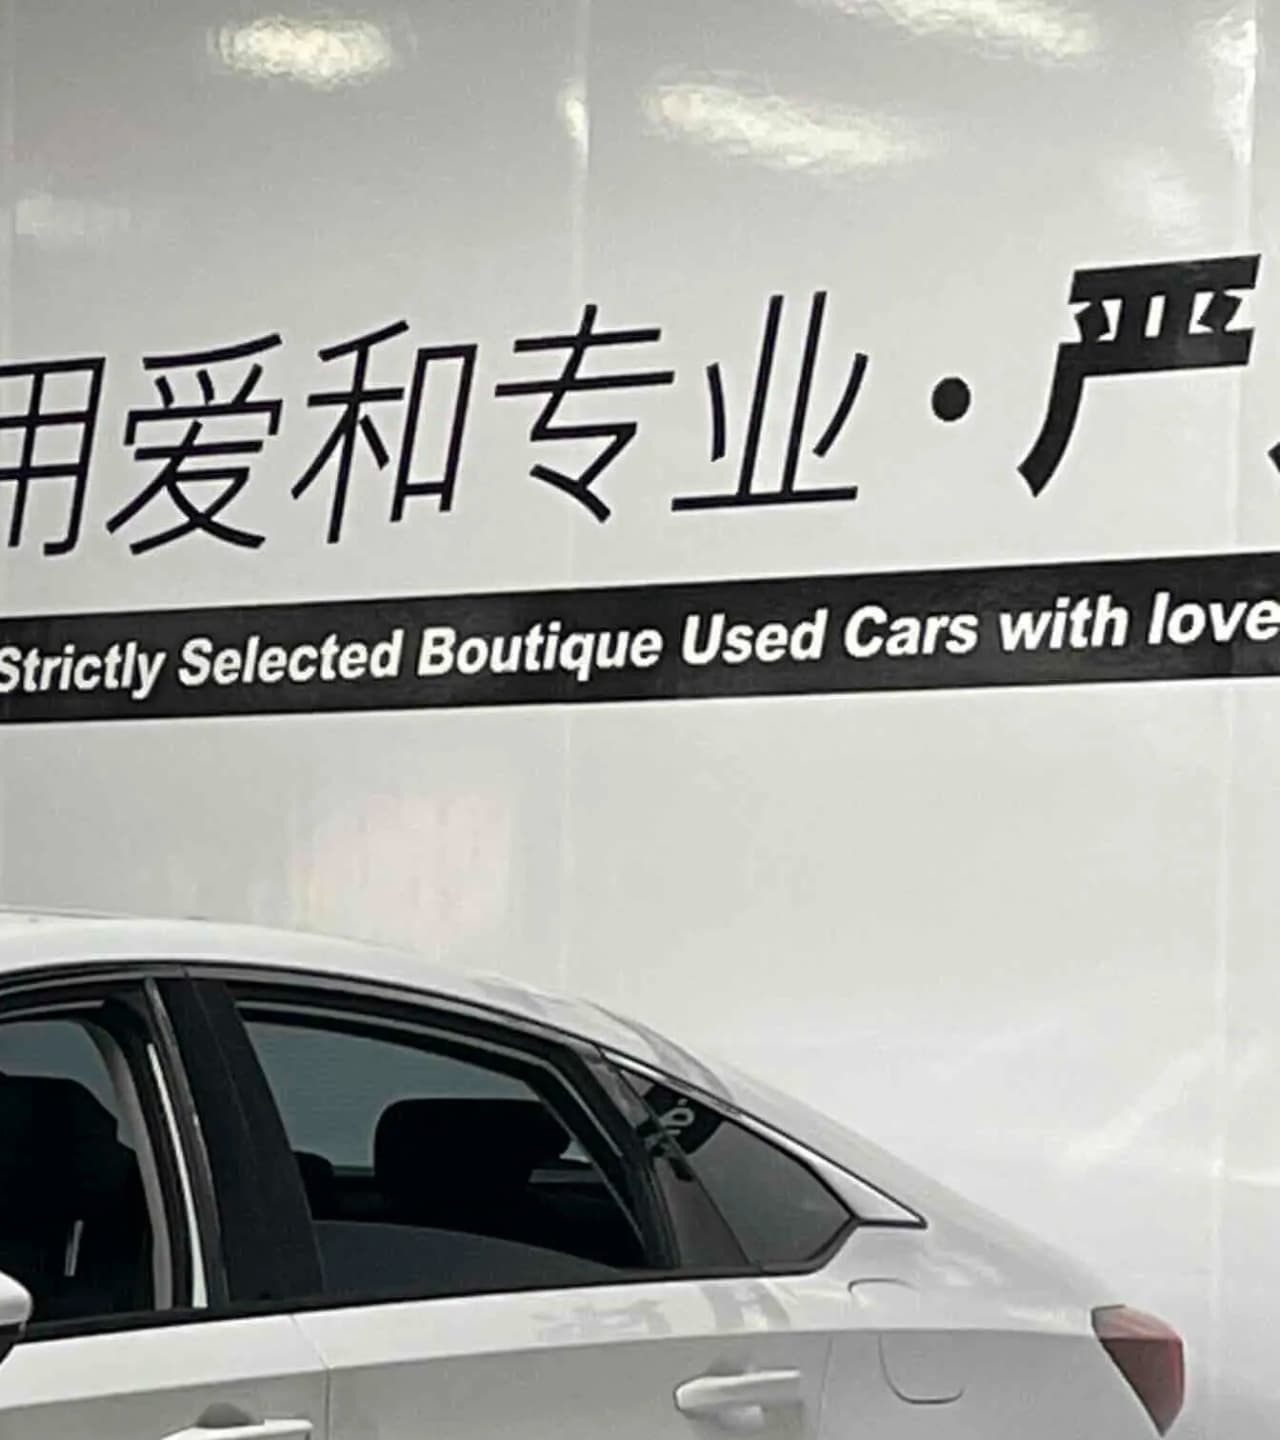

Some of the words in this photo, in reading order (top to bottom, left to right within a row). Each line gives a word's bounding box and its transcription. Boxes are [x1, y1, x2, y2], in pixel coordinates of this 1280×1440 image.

[176, 628, 405, 688] Selected
[416, 620, 664, 682] Boutique
[680, 608, 829, 666] Used
[843, 604, 979, 659] Cars
[998, 594, 1130, 652] with
[1146, 591, 1280, 646] love
